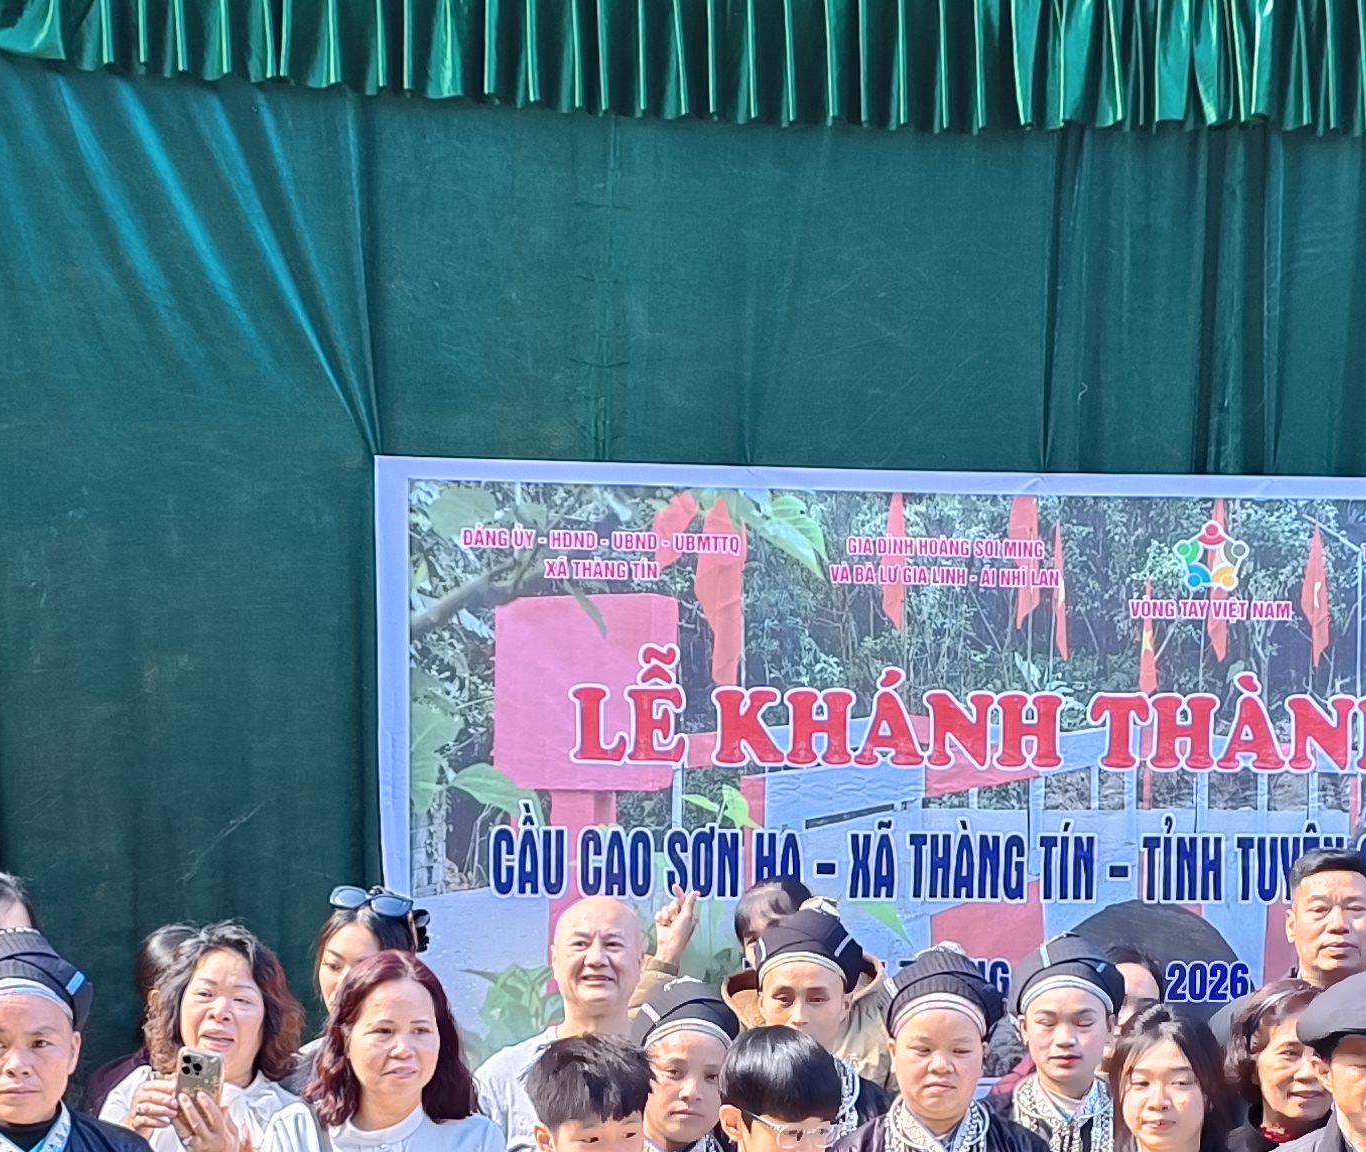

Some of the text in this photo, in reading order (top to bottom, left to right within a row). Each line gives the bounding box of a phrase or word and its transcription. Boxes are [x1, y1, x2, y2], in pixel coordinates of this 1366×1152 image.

[613, 533, 657, 550] UBND
[675, 535, 739, 554] UBMTTQ
[848, 537, 872, 554] GIA
[1004, 540, 1043, 558] MING
[546, 556, 567, 577] XÃ
[879, 565, 899, 583] LƯ
[903, 567, 927, 584] GIA
[932, 567, 966, 585] LINH
[1031, 569, 1059, 587] LAN
[1180, 601, 1208, 618] TAY
[1212, 598, 1247, 623] VIỆT
[1252, 603, 1290, 620] NAM
[571, 645, 687, 763] LỄ
[713, 668, 1063, 768] KHÁNH
[492, 801, 565, 895] CẦU
[580, 828, 652, 897] CAO
[666, 824, 739, 898] SƠN
[849, 819, 894, 899] XÃ
[910, 818, 1026, 901] THÀNG
[1039, 817, 1095, 901] TÍN
[1142, 815, 1223, 902] TỈNH
[1166, 961, 1251, 1001] 2026
